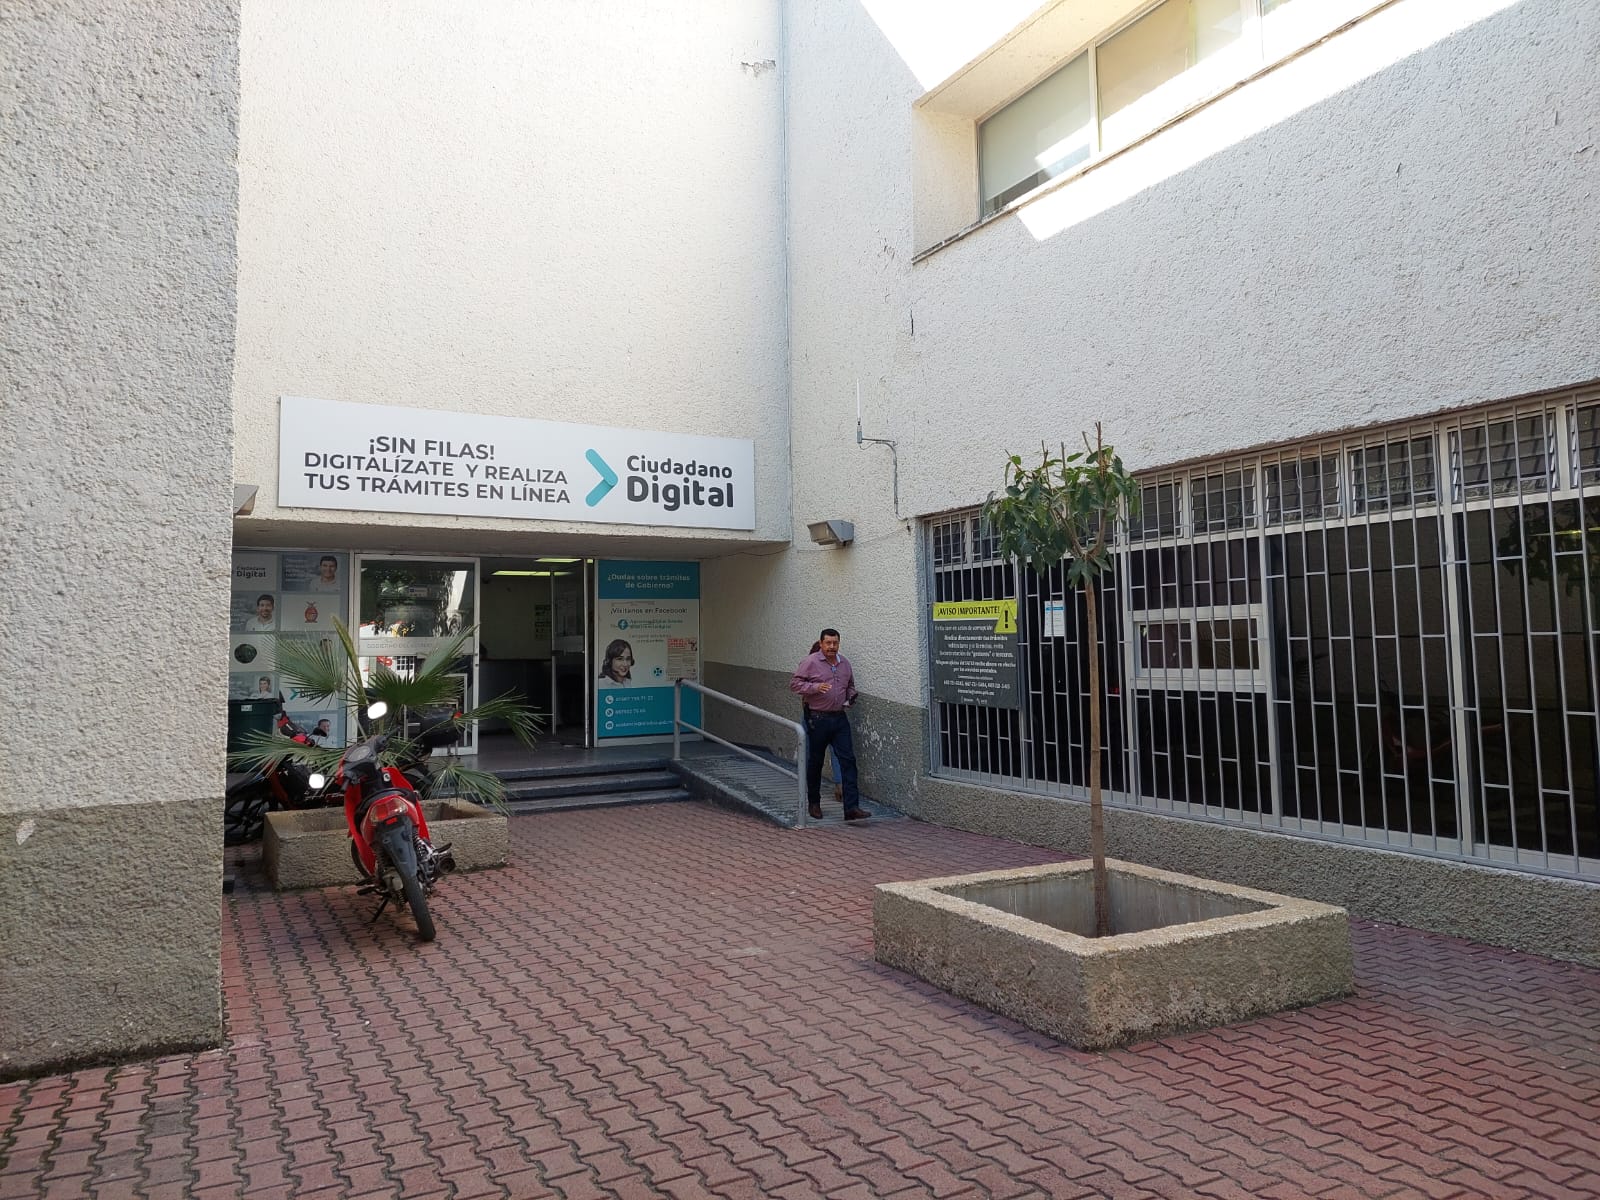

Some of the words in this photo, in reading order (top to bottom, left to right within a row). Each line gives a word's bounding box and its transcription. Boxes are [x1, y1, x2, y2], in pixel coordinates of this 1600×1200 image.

[369, 436, 416, 454] ¡SIN
[424, 439, 495, 460] FILAS!
[304, 452, 454, 477] DIGITALÍZATE
[465, 463, 478, 478] Y
[485, 466, 568, 484] REALIZA
[627, 455, 733, 479] Ciudadano
[304, 473, 350, 491] TUS
[357, 475, 469, 498] TRÁMITES
[476, 484, 504, 500] EN
[511, 484, 571, 504] LÍNEA
[627, 475, 734, 512] Digital
[236, 570, 267, 579] Digital
[938, 607, 957, 616] ¡AVISO
[957, 605, 1000, 615] IMPORTANTE!
